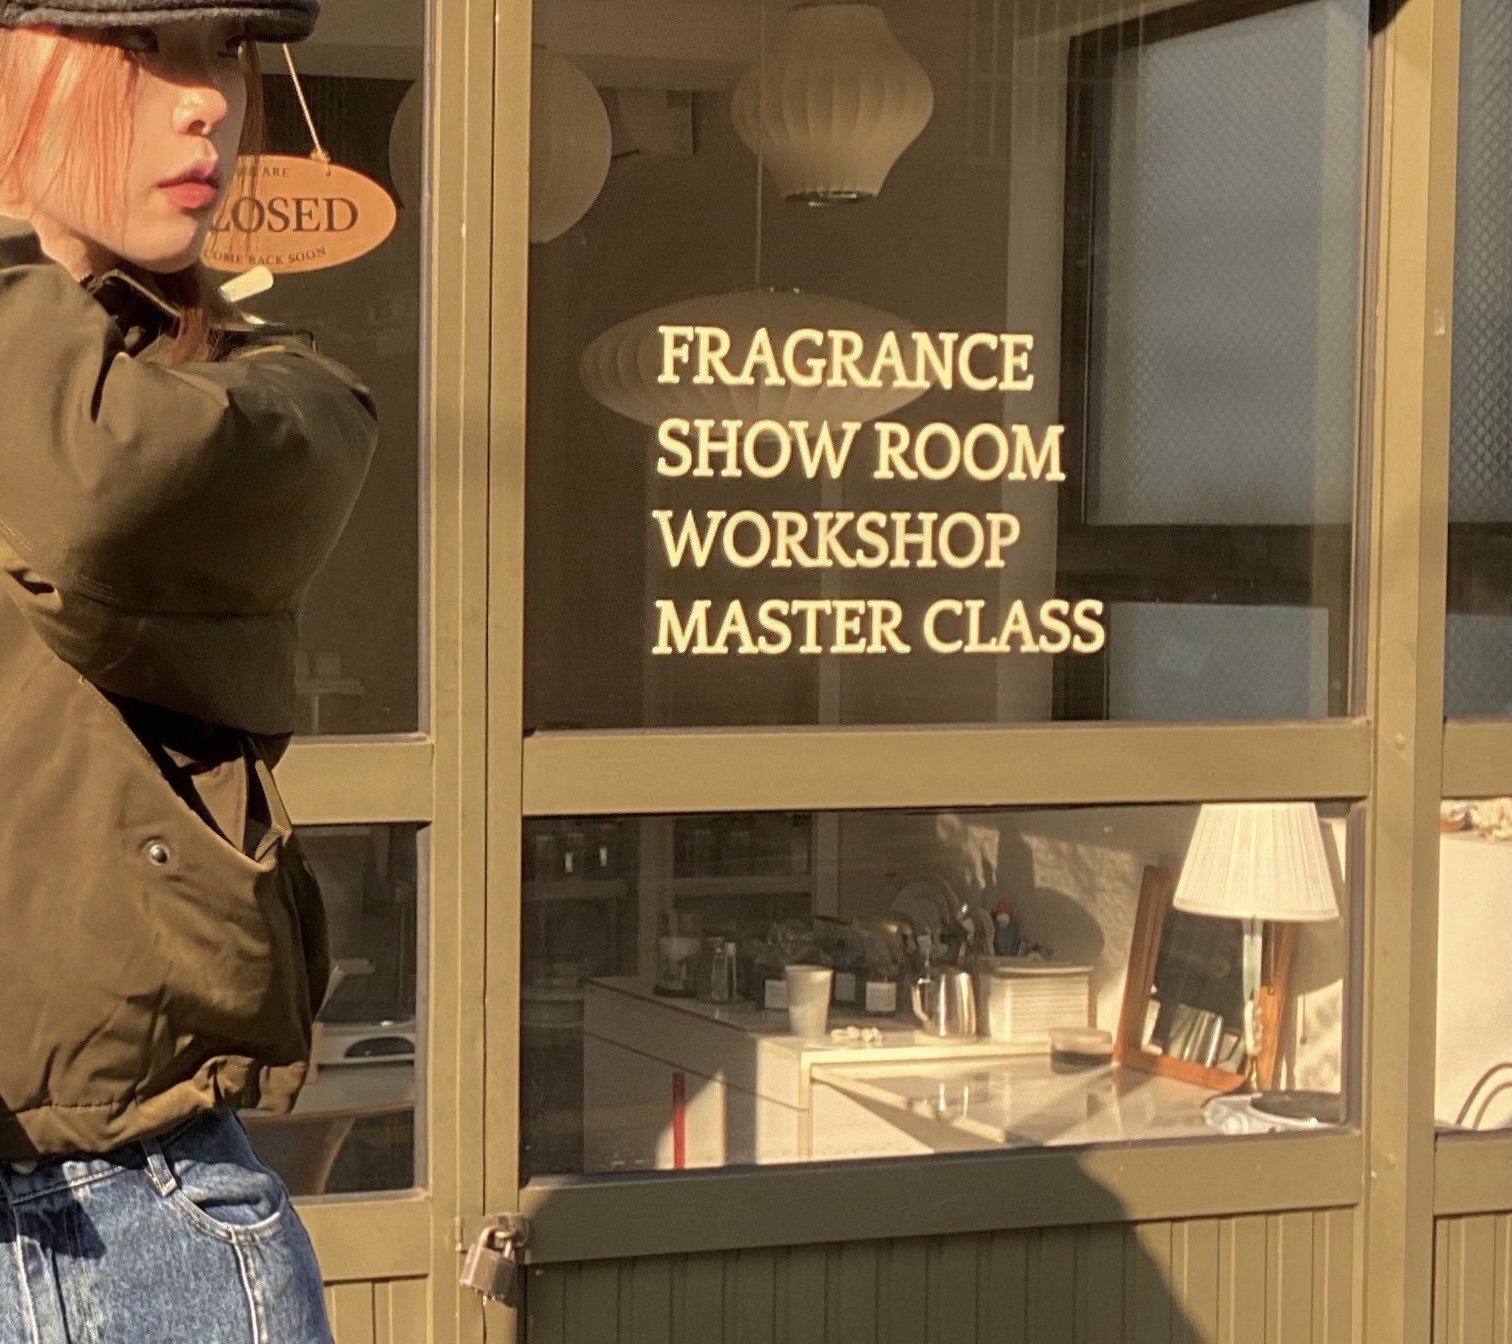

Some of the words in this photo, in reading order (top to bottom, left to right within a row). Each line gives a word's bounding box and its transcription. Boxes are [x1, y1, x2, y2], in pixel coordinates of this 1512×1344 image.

[262, 166, 291, 178] ARE
[248, 254, 284, 266] BACK
[288, 246, 327, 264] SOON
[656, 324, 1035, 392] FRAGRANCE
[655, 418, 862, 480] SHOW
[872, 422, 1066, 482] ROOM
[651, 508, 1021, 569] WORKSHOP
[651, 598, 911, 655] MASTER
[922, 599, 1106, 655] CLASS
